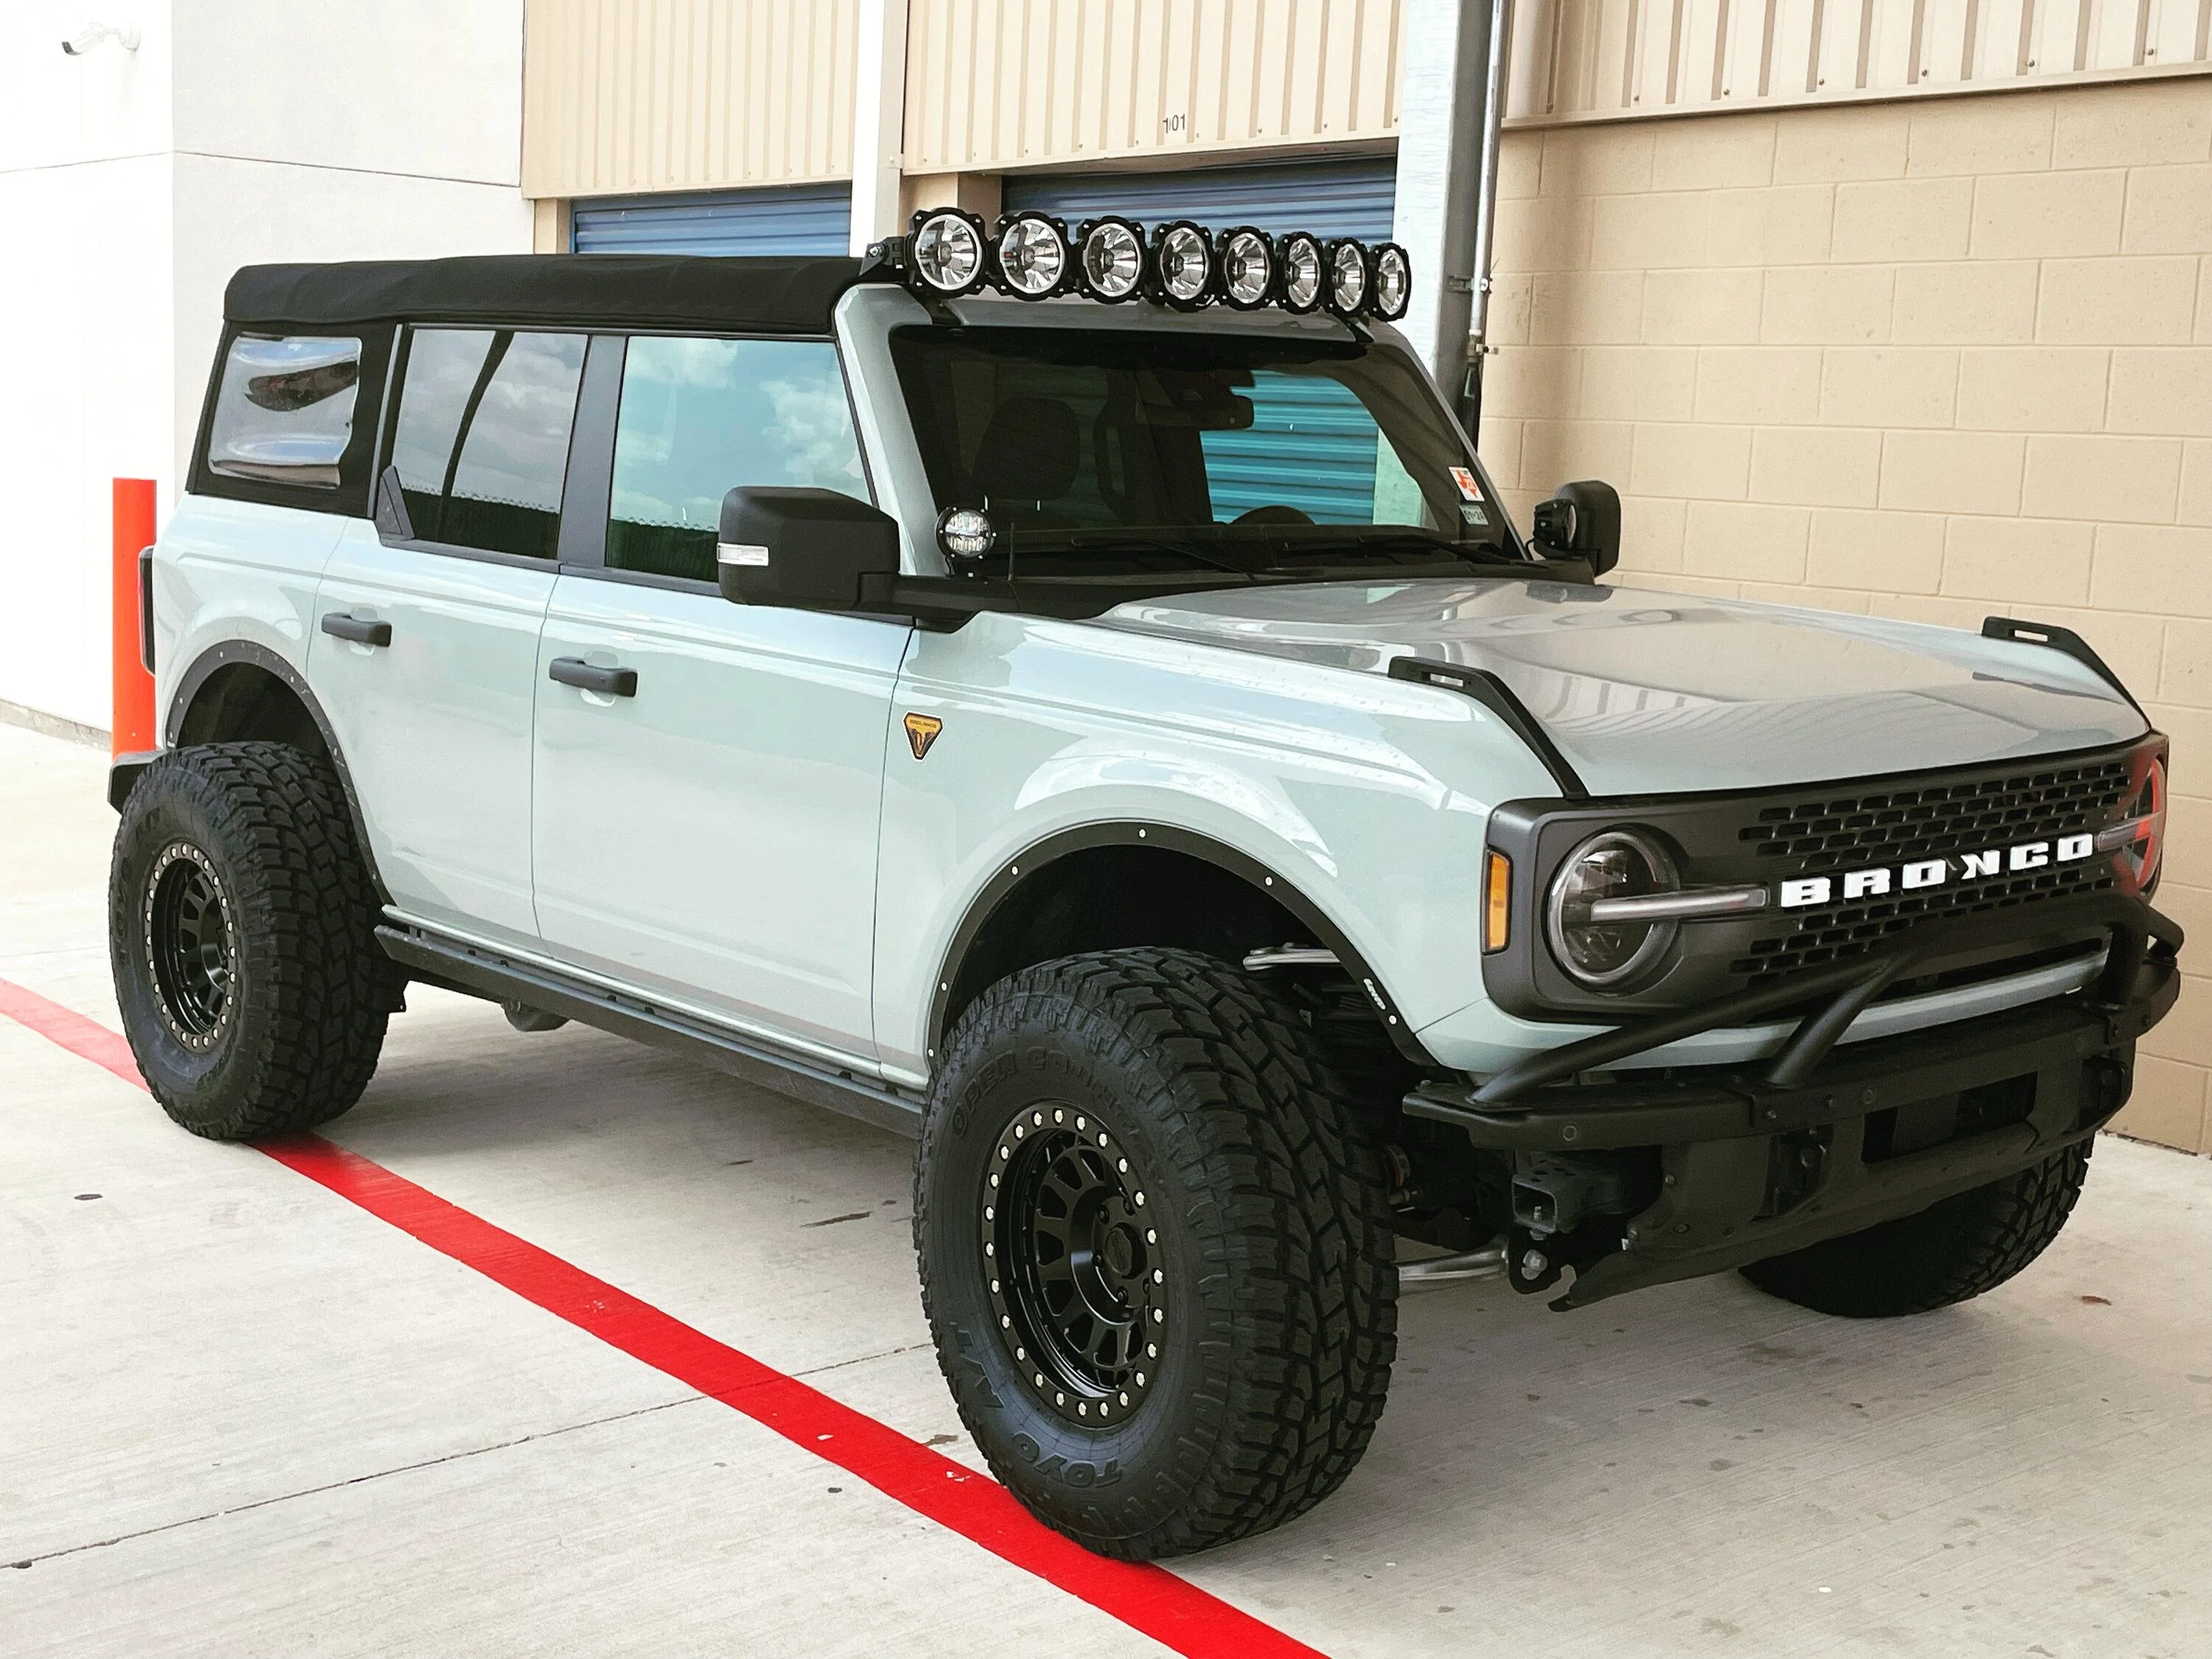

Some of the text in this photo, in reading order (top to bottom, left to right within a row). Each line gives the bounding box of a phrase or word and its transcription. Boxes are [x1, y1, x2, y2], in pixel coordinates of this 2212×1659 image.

[1162, 114, 1186, 133] 101
[1781, 833, 2093, 908] BRONCO
[952, 1049, 1017, 1138] OPEN
[1012, 1431, 1124, 1488] TOYO
